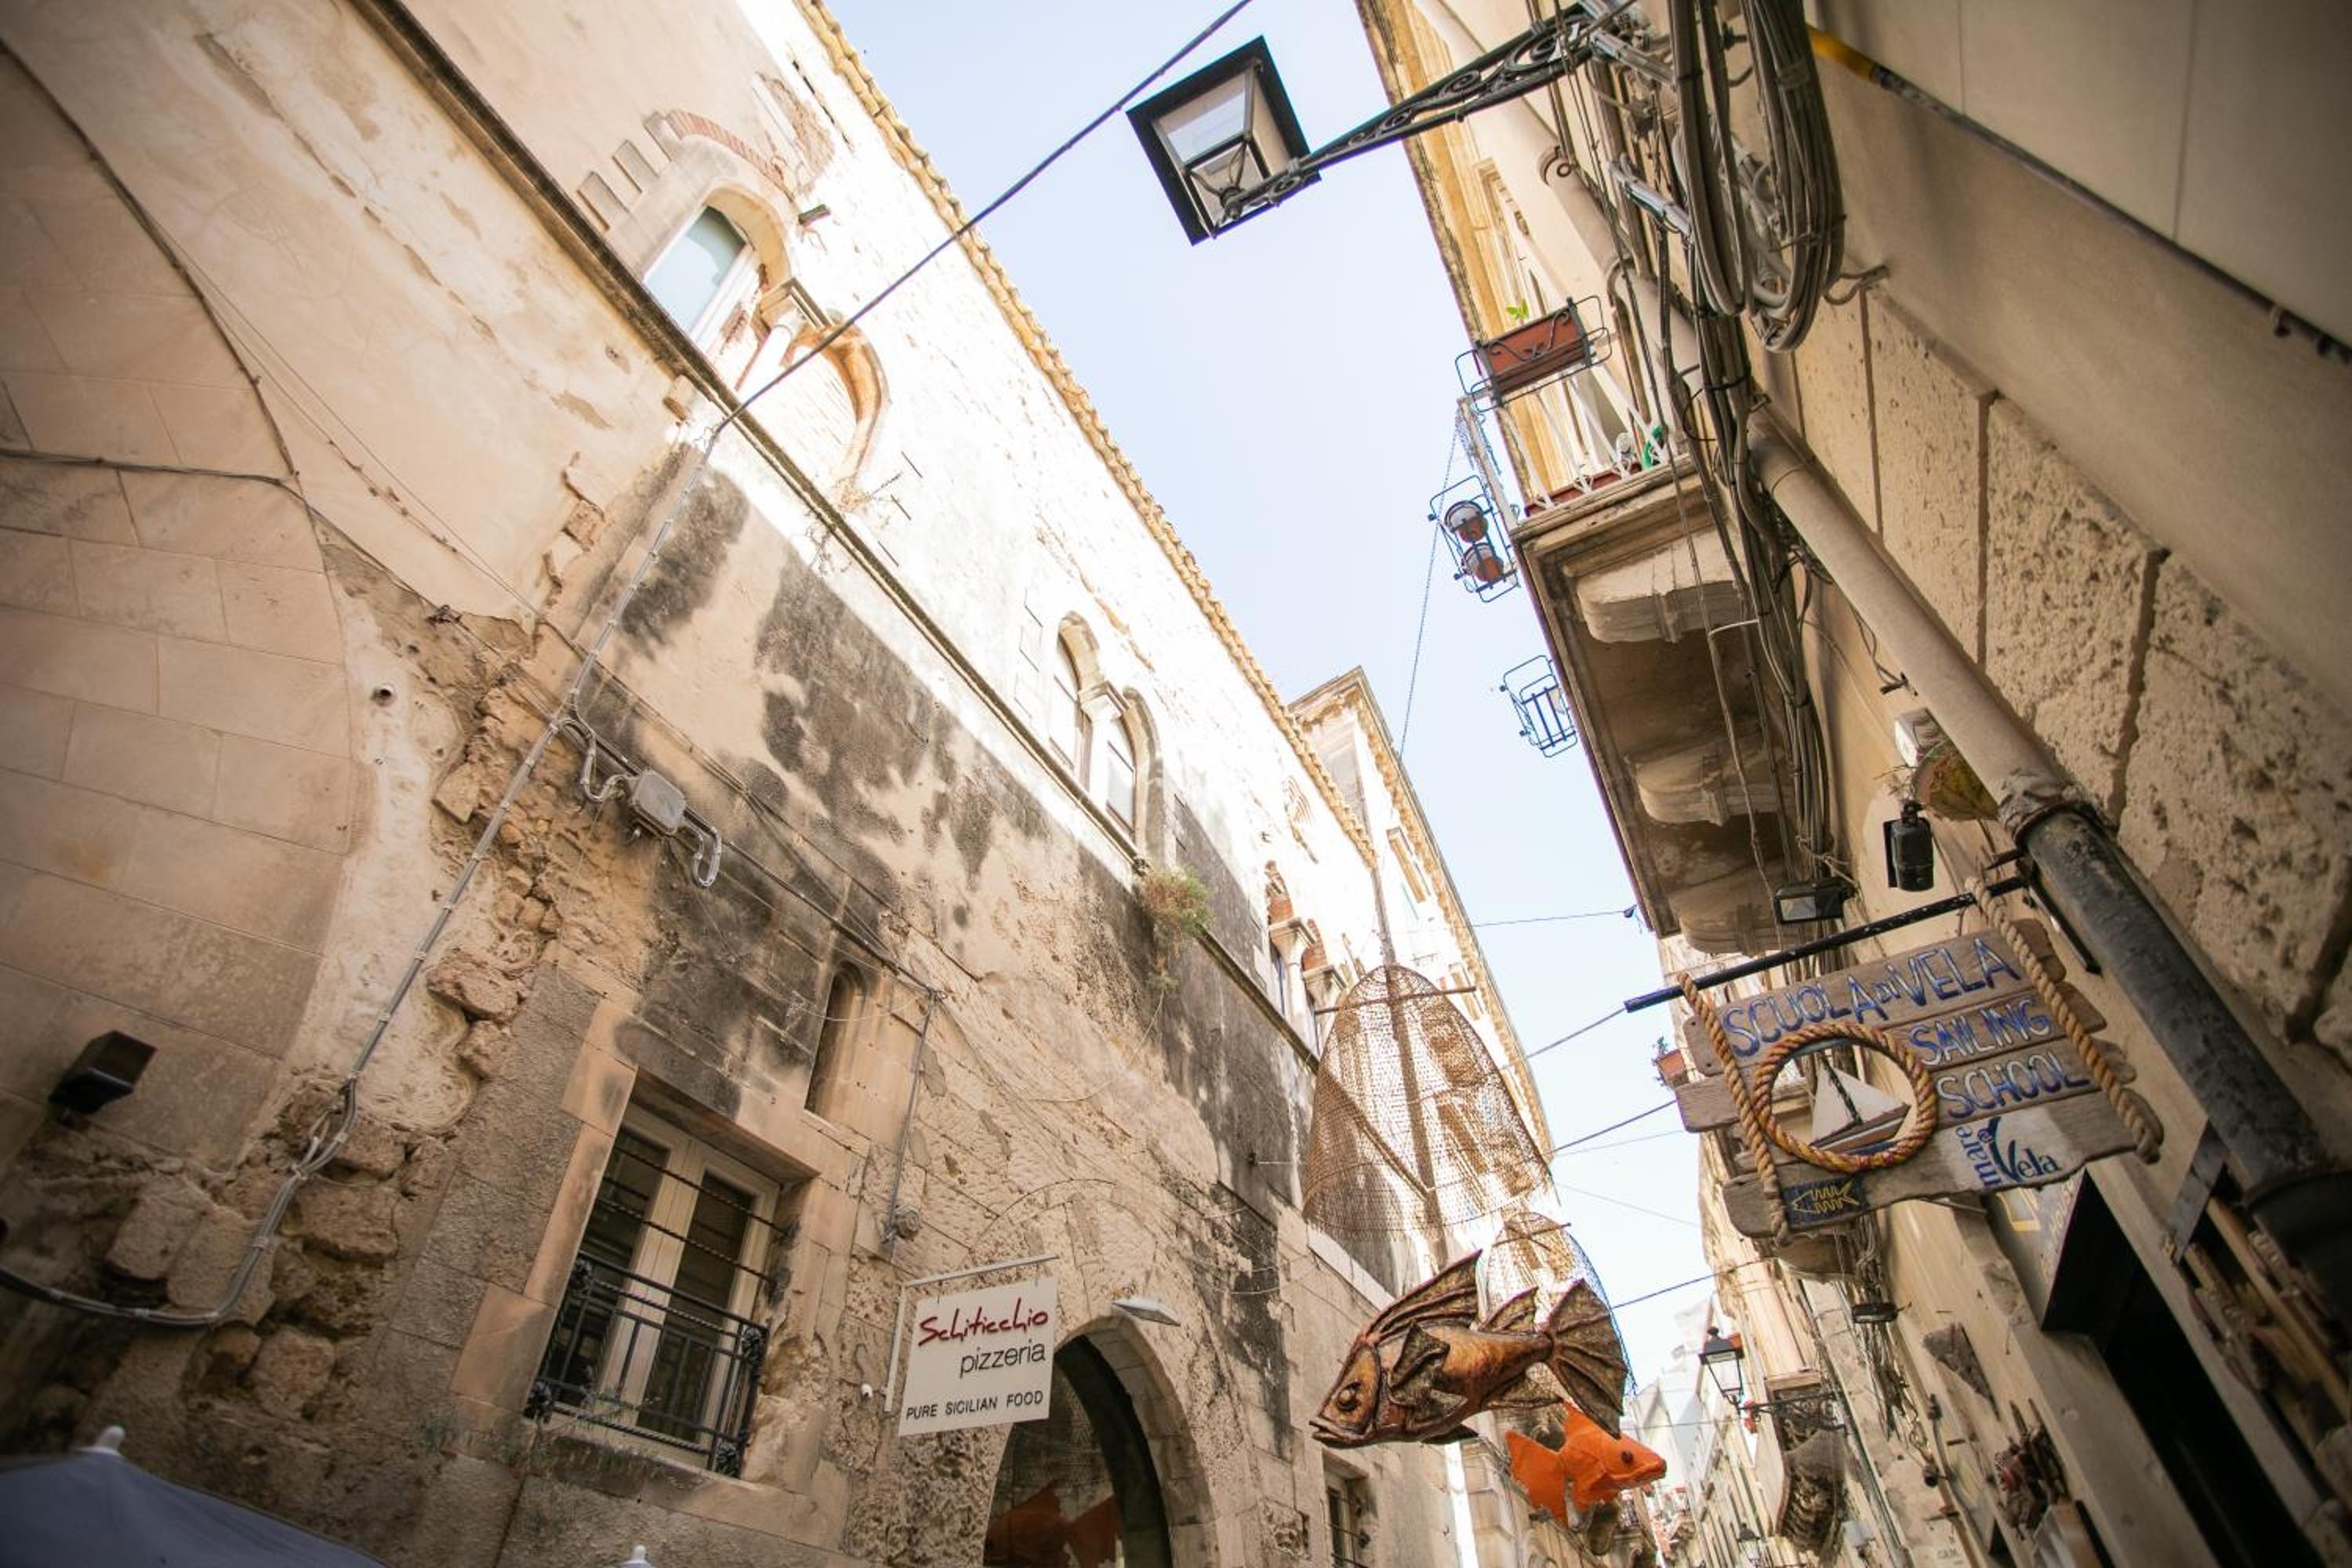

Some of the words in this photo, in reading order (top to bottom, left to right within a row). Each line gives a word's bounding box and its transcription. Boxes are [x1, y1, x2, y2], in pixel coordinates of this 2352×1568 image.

[1724, 974, 1889, 1058] SCUOLA
[1886, 938, 2021, 1007] VELA
[1907, 999, 2051, 1066] SAILING
[1936, 1051, 2091, 1120] SCHOOL
[1955, 1127, 2002, 1186] mare
[1987, 1116, 2062, 1183] Vela
[918, 1297, 1049, 1347] Schiticchio
[959, 1338, 1046, 1379] pizzeria
[906, 1404, 938, 1421] PURE
[945, 1396, 998, 1416] SICILIAN
[1006, 1390, 1044, 1409] FOOD
